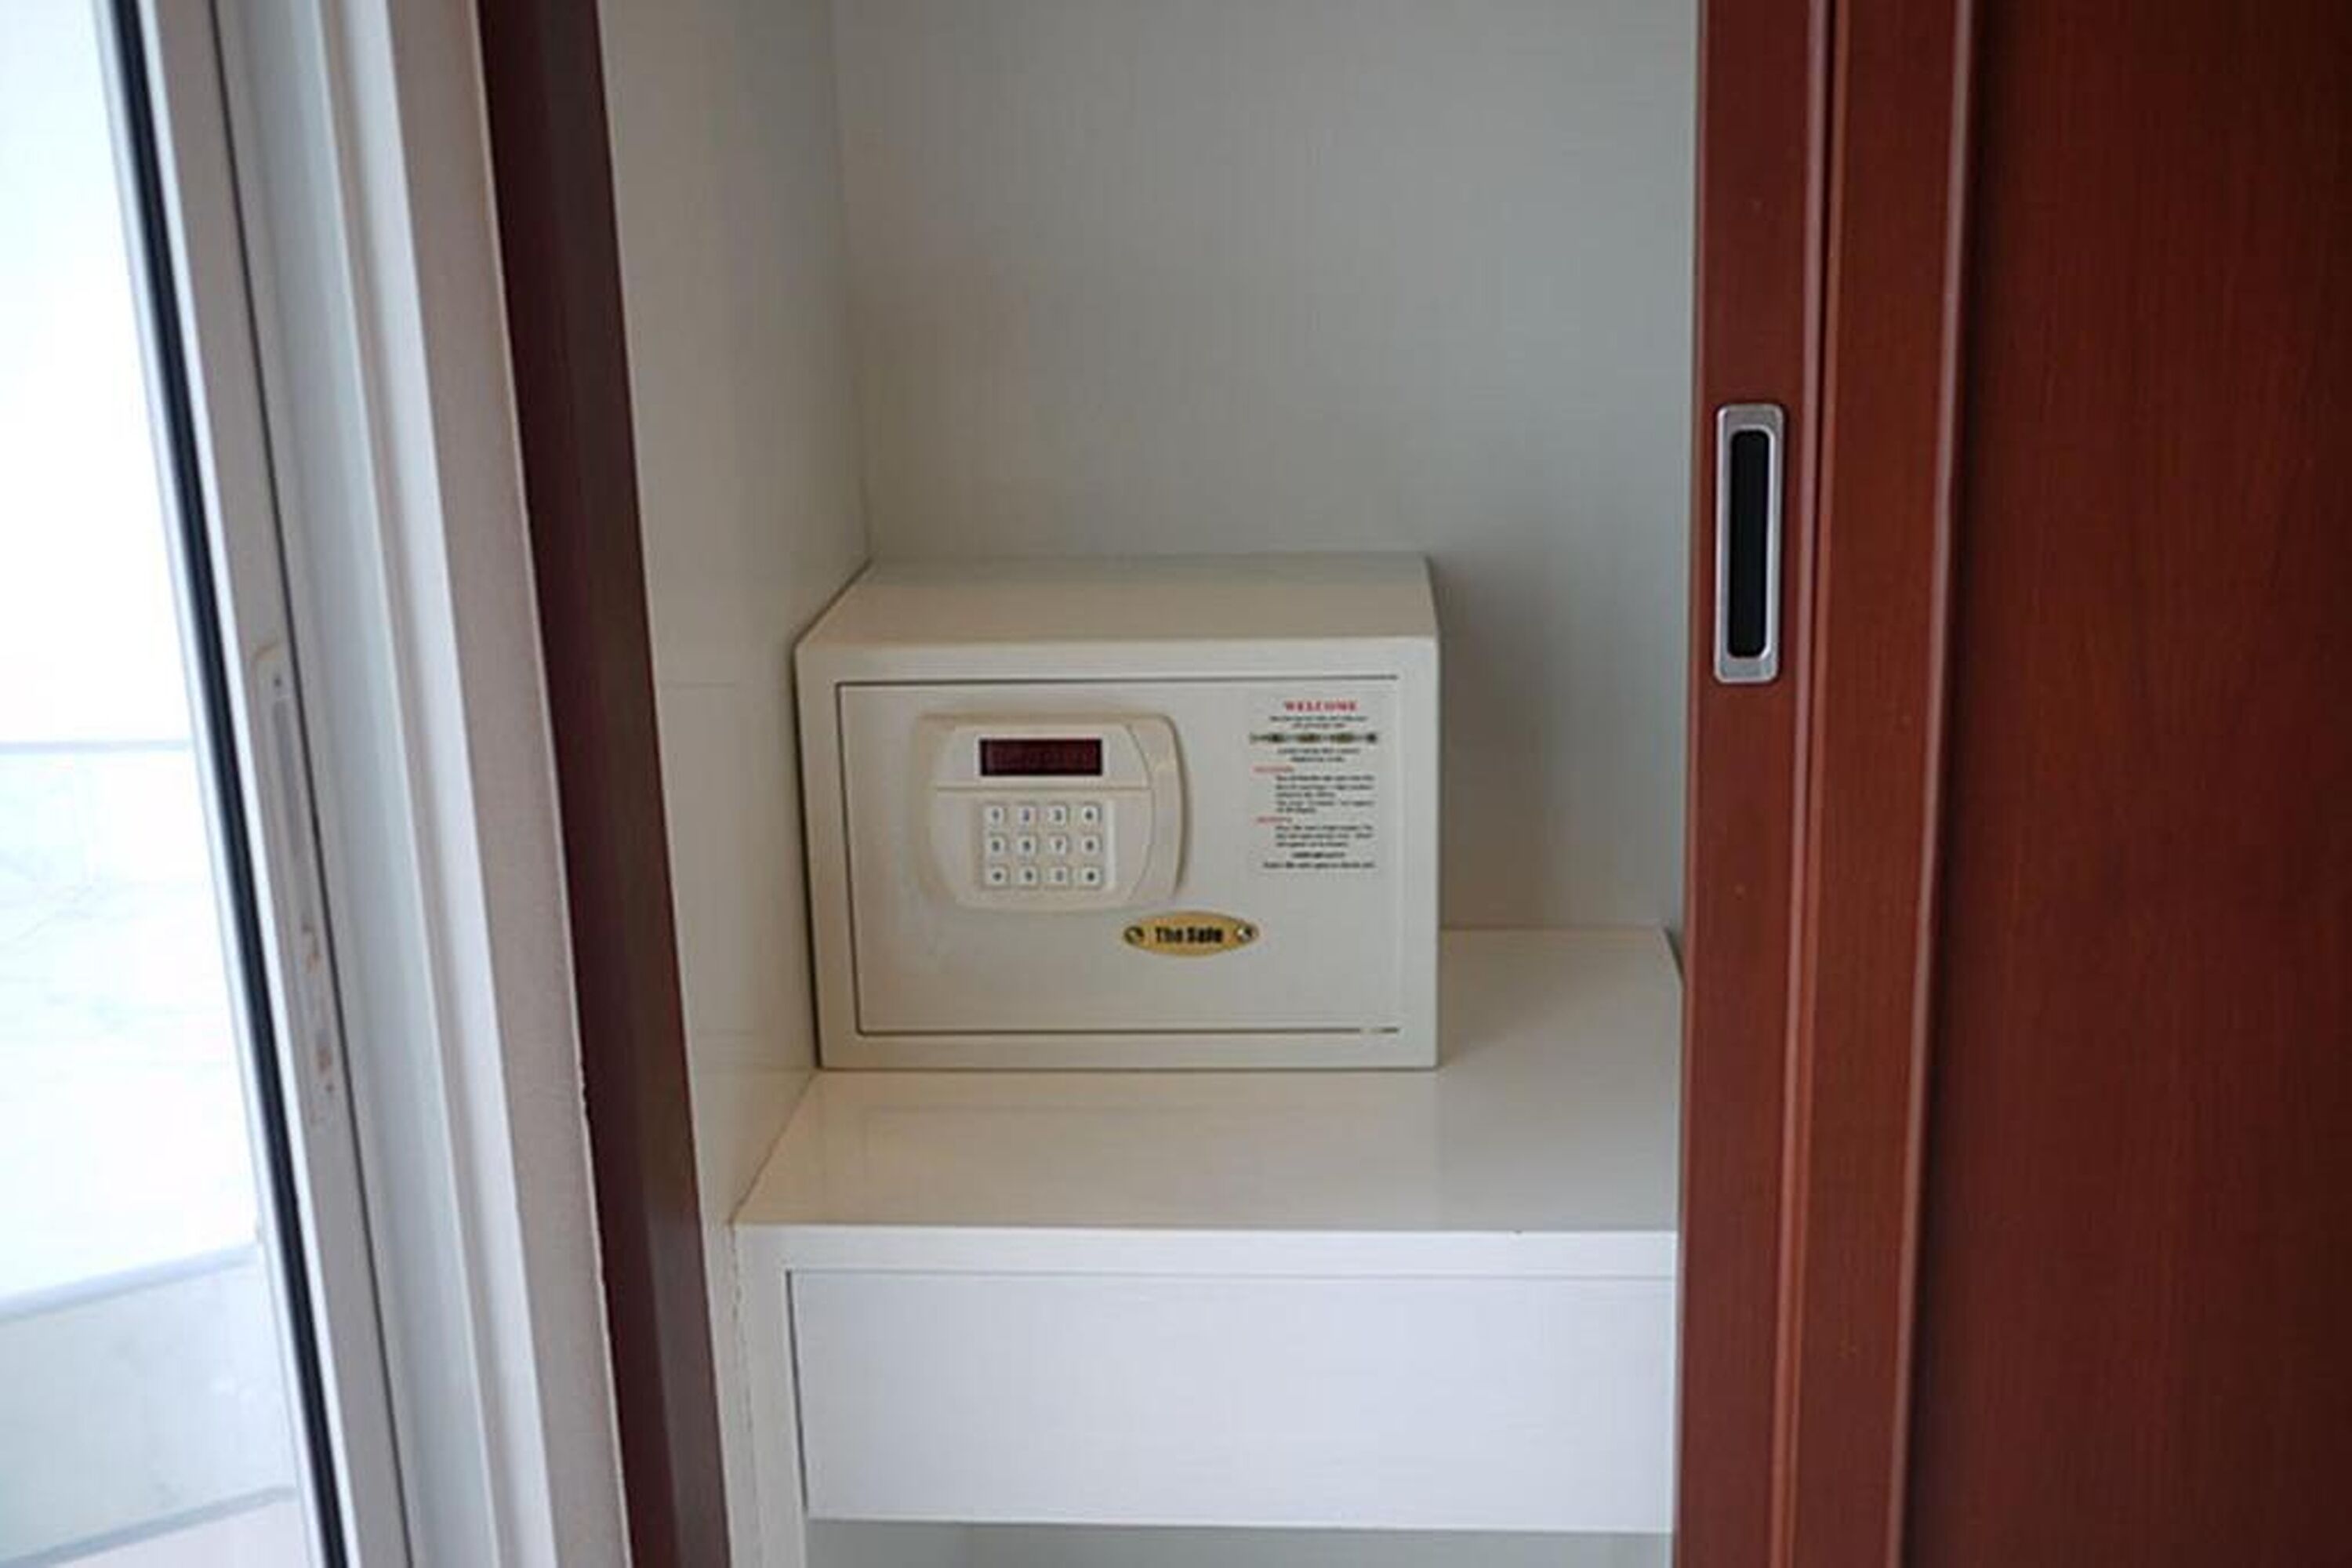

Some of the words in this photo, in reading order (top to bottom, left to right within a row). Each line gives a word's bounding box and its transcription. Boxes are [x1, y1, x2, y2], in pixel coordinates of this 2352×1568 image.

[1283, 700, 1357, 711] WELCOME
[1156, 927, 1182, 942] The
[1188, 927, 1223, 943] Safe
